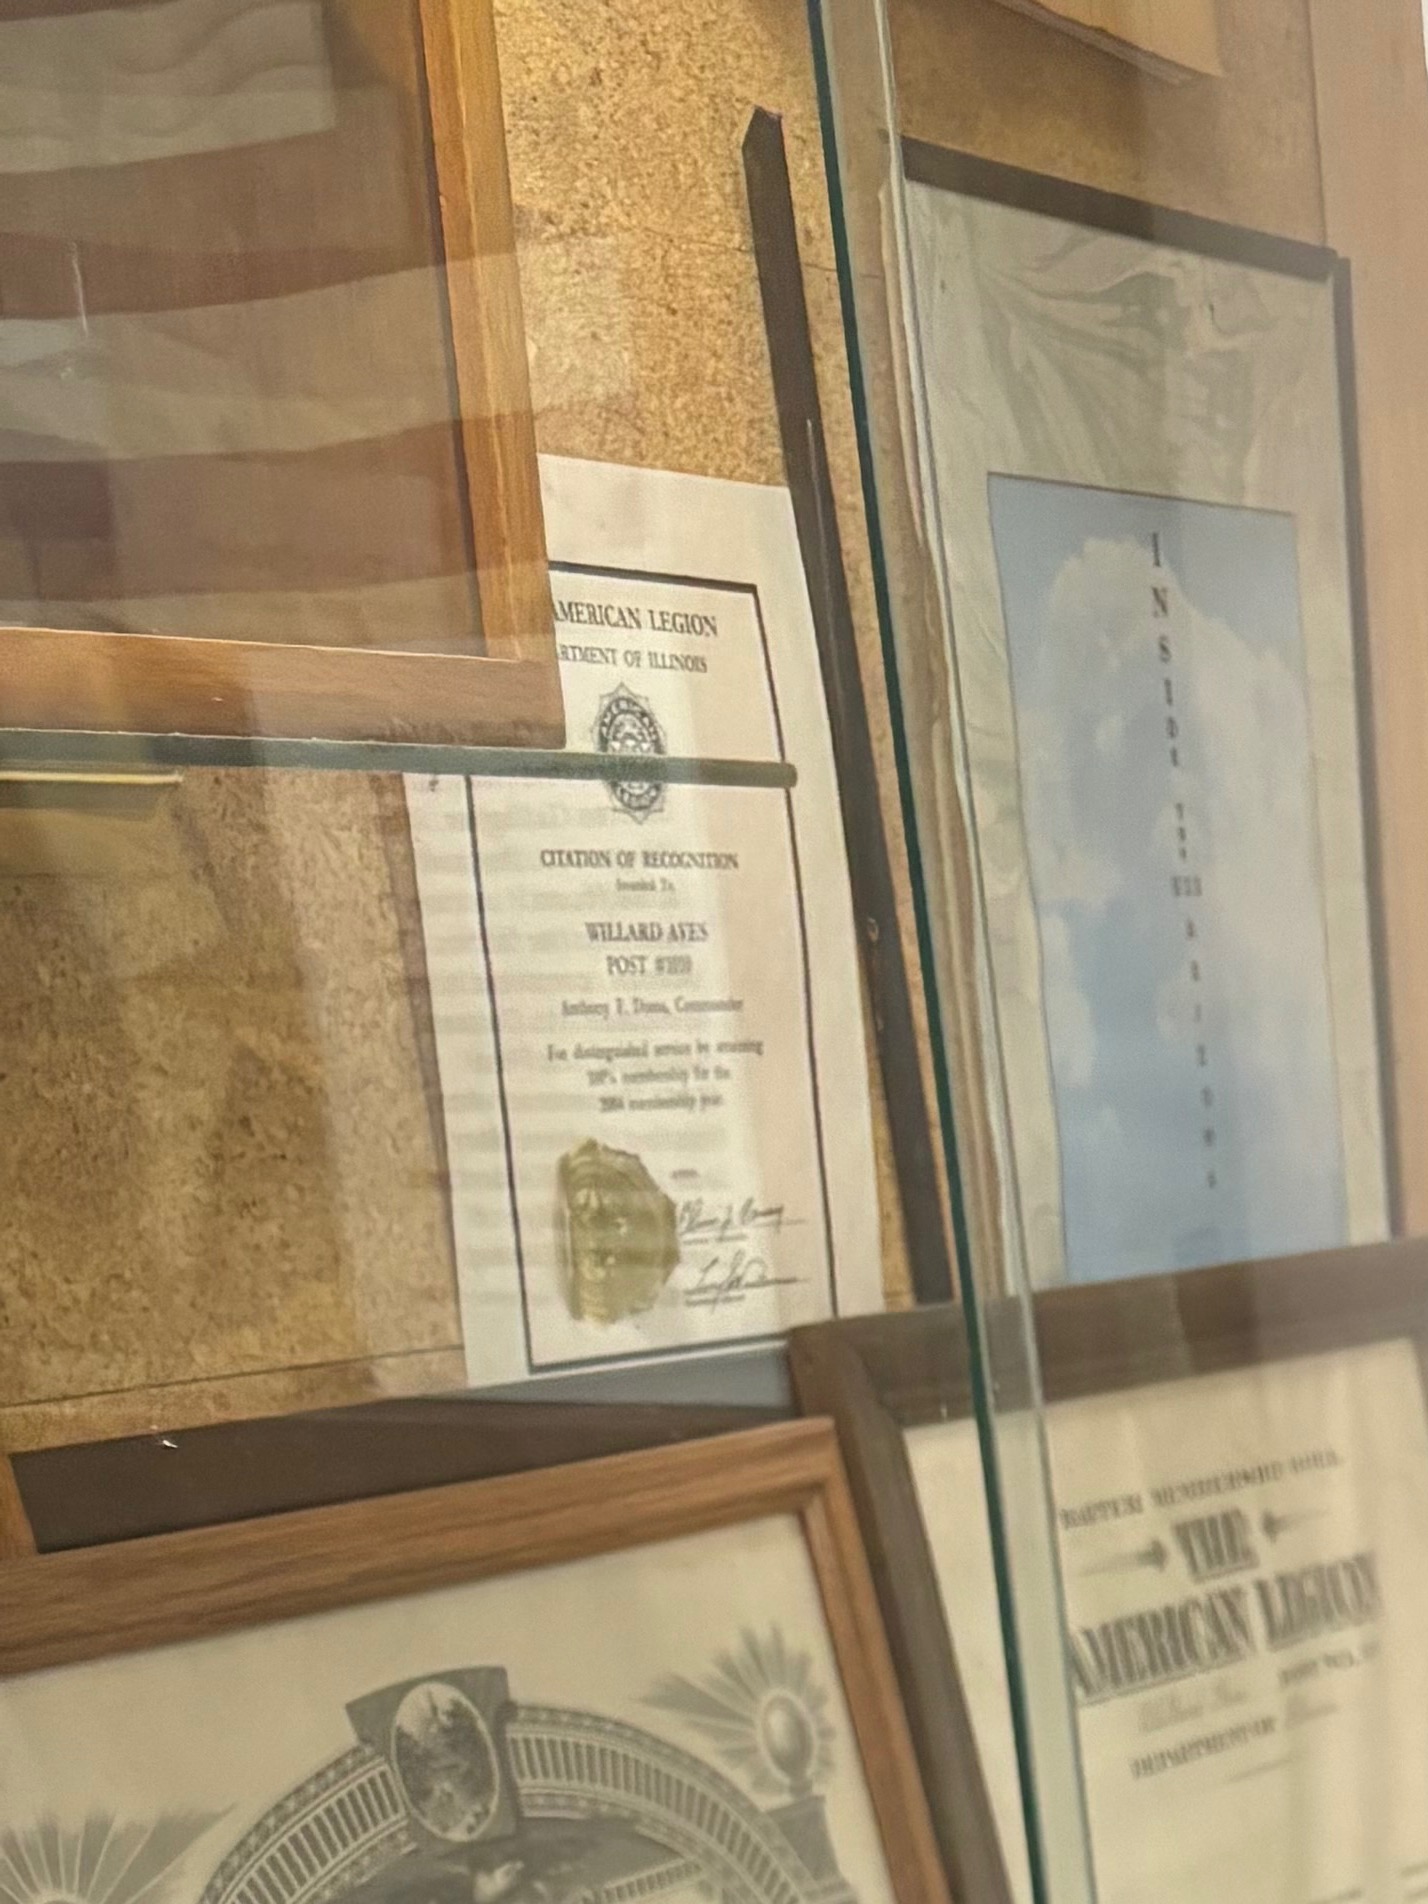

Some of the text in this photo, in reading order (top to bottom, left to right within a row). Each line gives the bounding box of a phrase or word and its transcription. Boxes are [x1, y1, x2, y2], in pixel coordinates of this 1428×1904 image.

[648, 608, 718, 637] LEGION
[559, 643, 708, 674] RTMENT OF ILLINOIS
[540, 849, 740, 869] CITATION OF RECOGNITION
[584, 921, 663, 942] WILLARD
[606, 954, 647, 976] POST
[1072, 1586, 1250, 1703] AMERICAN
[1258, 1552, 1380, 1649] LEGION
